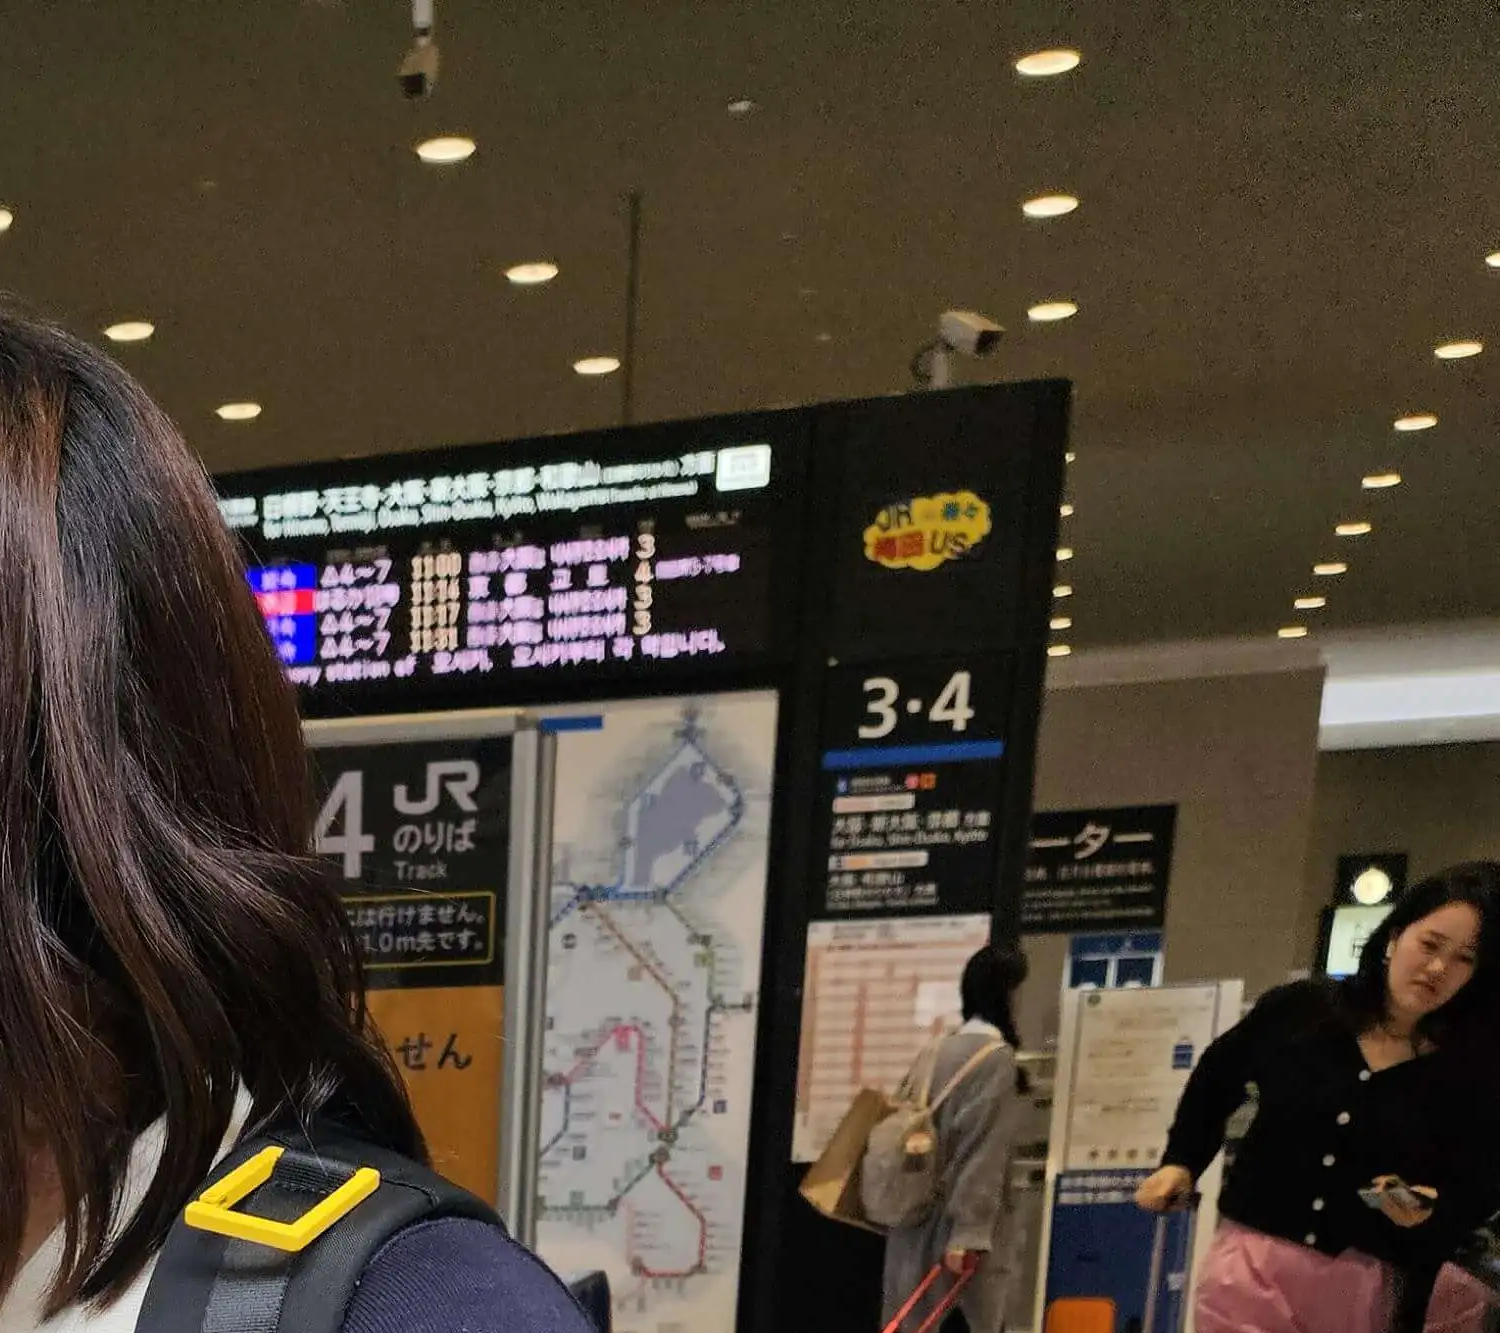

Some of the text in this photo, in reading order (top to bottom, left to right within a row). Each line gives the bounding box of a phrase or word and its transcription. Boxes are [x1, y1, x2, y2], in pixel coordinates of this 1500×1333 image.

[314, 760, 481, 879] 4 JR
[393, 818, 477, 854] のりば
[393, 860, 449, 881] Track
[395, 1032, 474, 1071] せん
